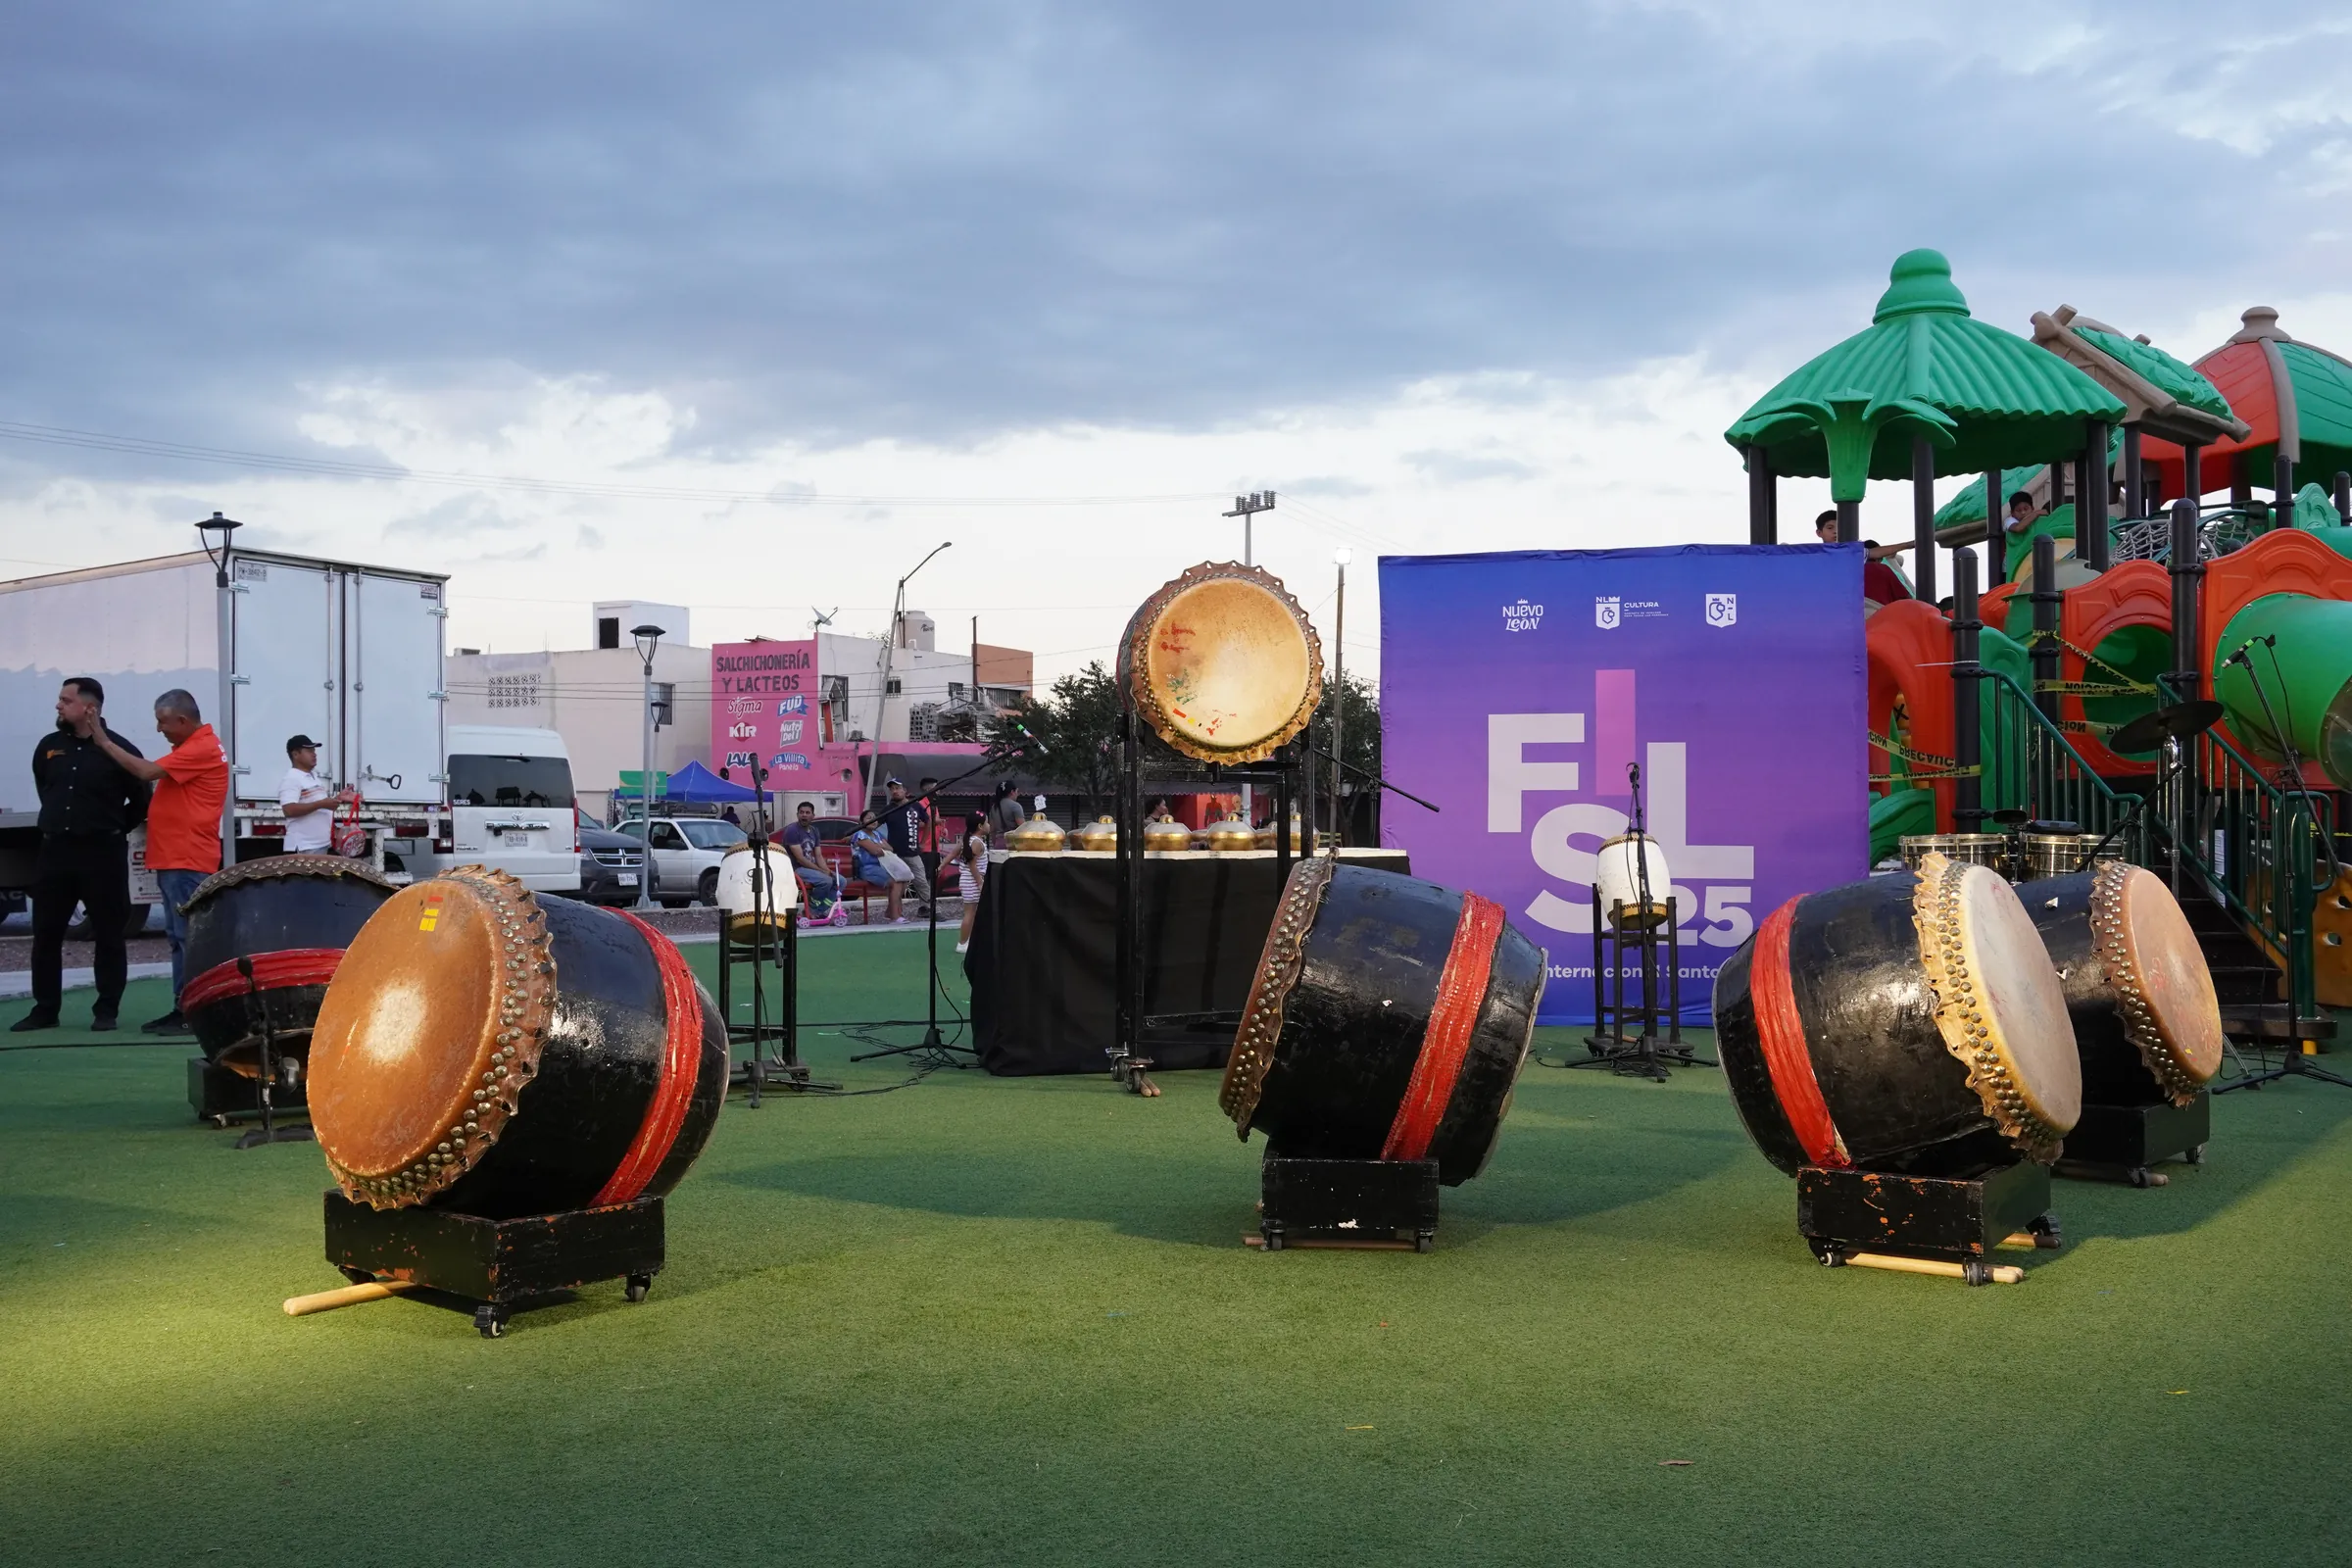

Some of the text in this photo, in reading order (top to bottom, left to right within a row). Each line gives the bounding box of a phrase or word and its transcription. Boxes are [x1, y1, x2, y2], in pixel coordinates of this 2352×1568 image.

[715, 649, 810, 672] SALCHICHONERÍA
[721, 674, 800, 694] Y LACTEOS
[728, 697, 762, 719] Sigma
[779, 695, 803, 714] FUD
